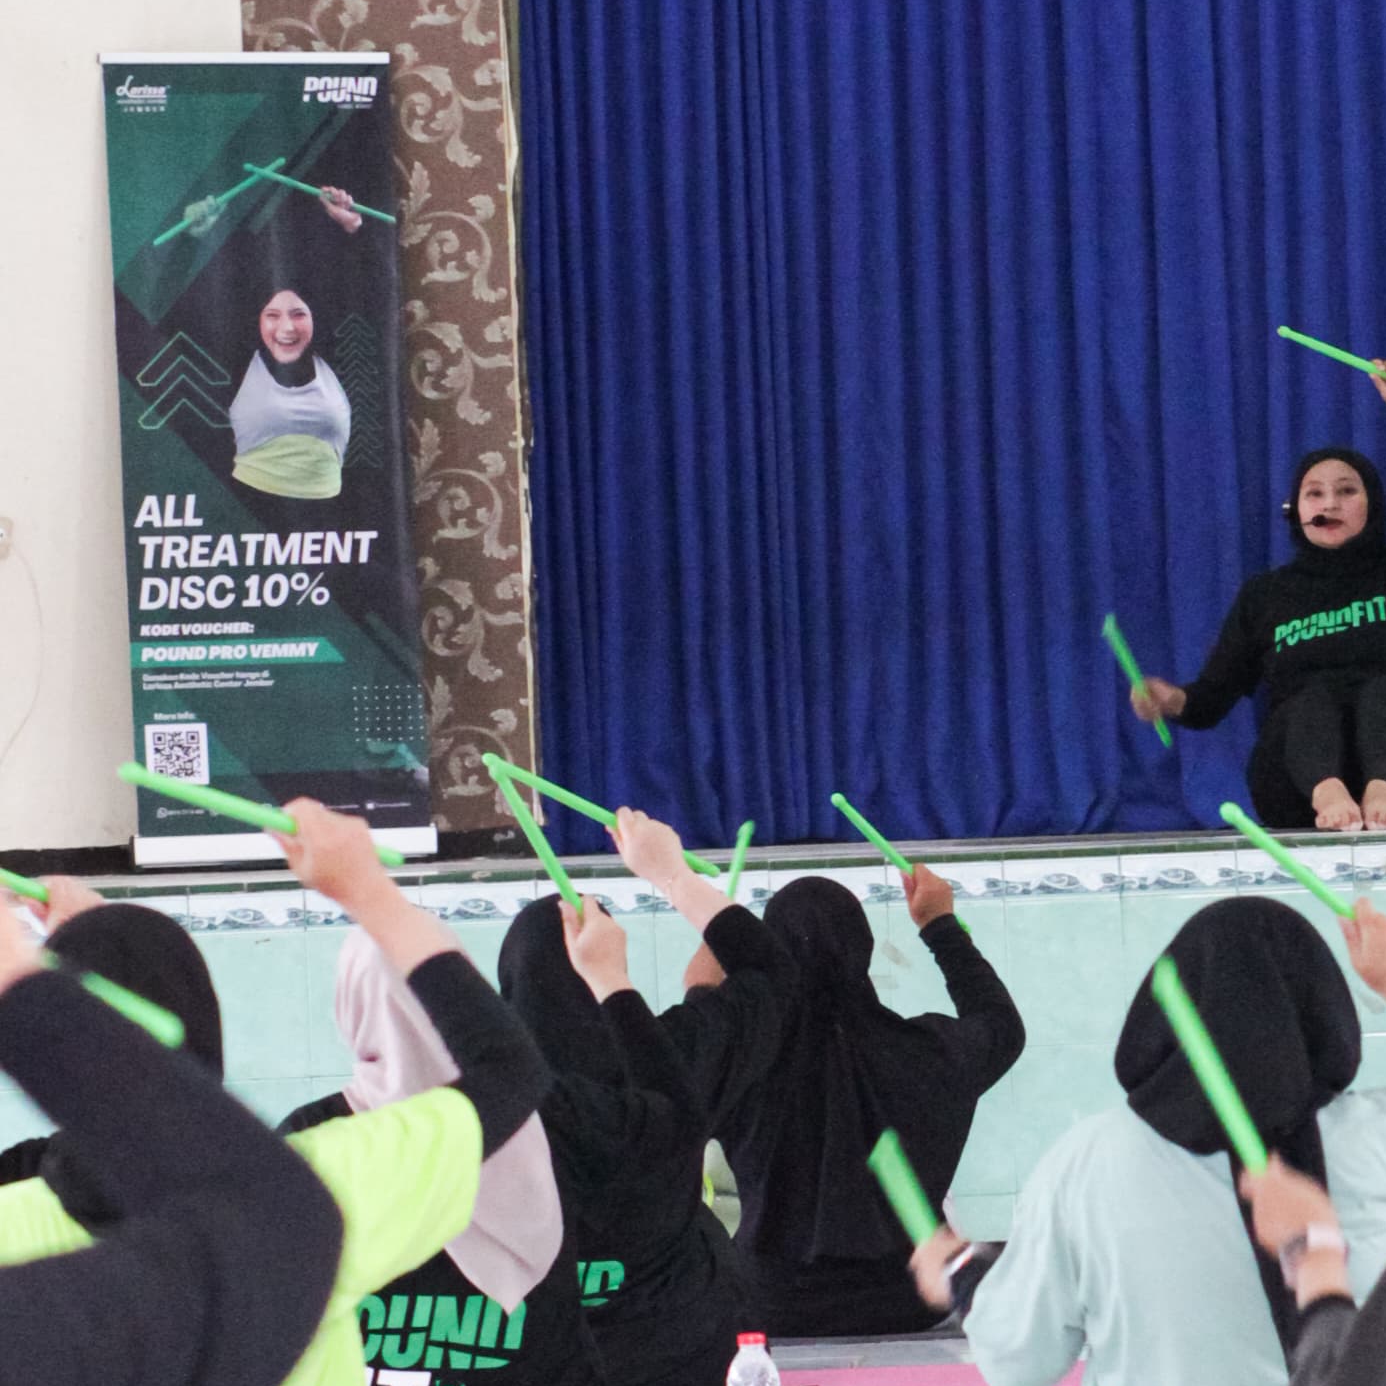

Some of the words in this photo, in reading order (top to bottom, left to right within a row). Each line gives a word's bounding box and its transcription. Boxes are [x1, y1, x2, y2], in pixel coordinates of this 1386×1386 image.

[303, 76, 377, 102] POUND
[134, 494, 203, 528] ALL
[138, 530, 378, 569] TREATMENT
[139, 574, 236, 611] DISC
[242, 571, 330, 608] 10%
[140, 623, 180, 637] KODE
[181, 621, 255, 636] VOUCHER:
[141, 646, 207, 662] POUND
[208, 644, 249, 661] PRO
[250, 641, 320, 659] VEMMY
